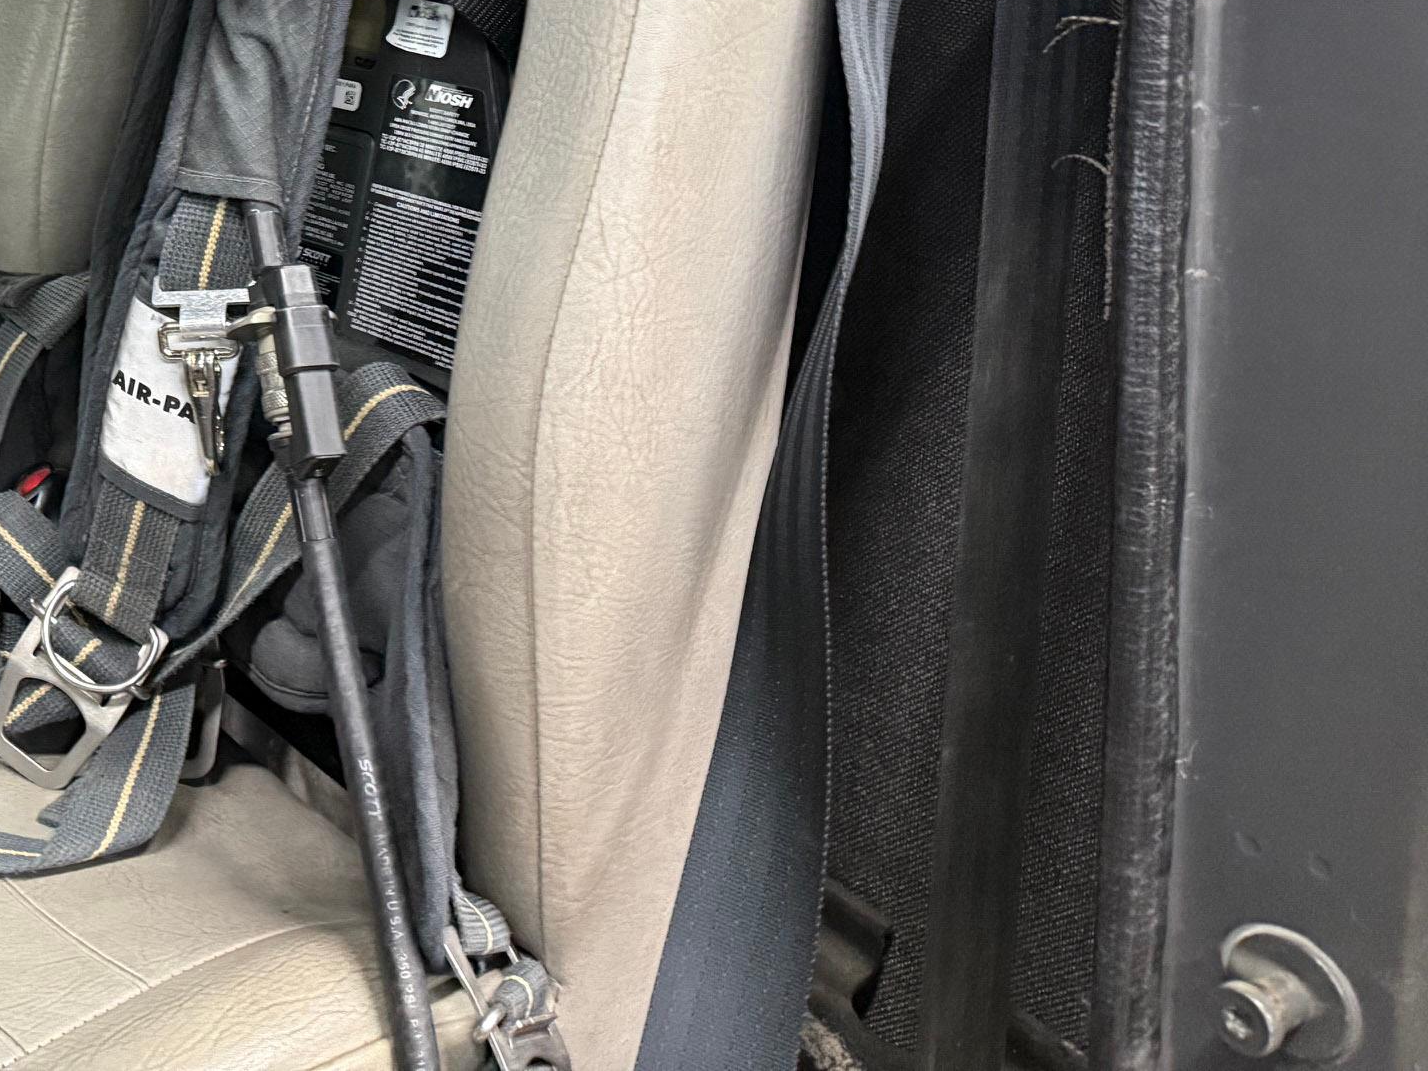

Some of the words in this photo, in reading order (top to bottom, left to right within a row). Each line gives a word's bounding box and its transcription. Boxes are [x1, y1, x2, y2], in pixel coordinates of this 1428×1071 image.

[426, 84, 474, 109] NIOSH
[304, 247, 332, 262] SCOTT
[112, 370, 197, 425] AIR-PA
[358, 758, 383, 822] SCOTT
